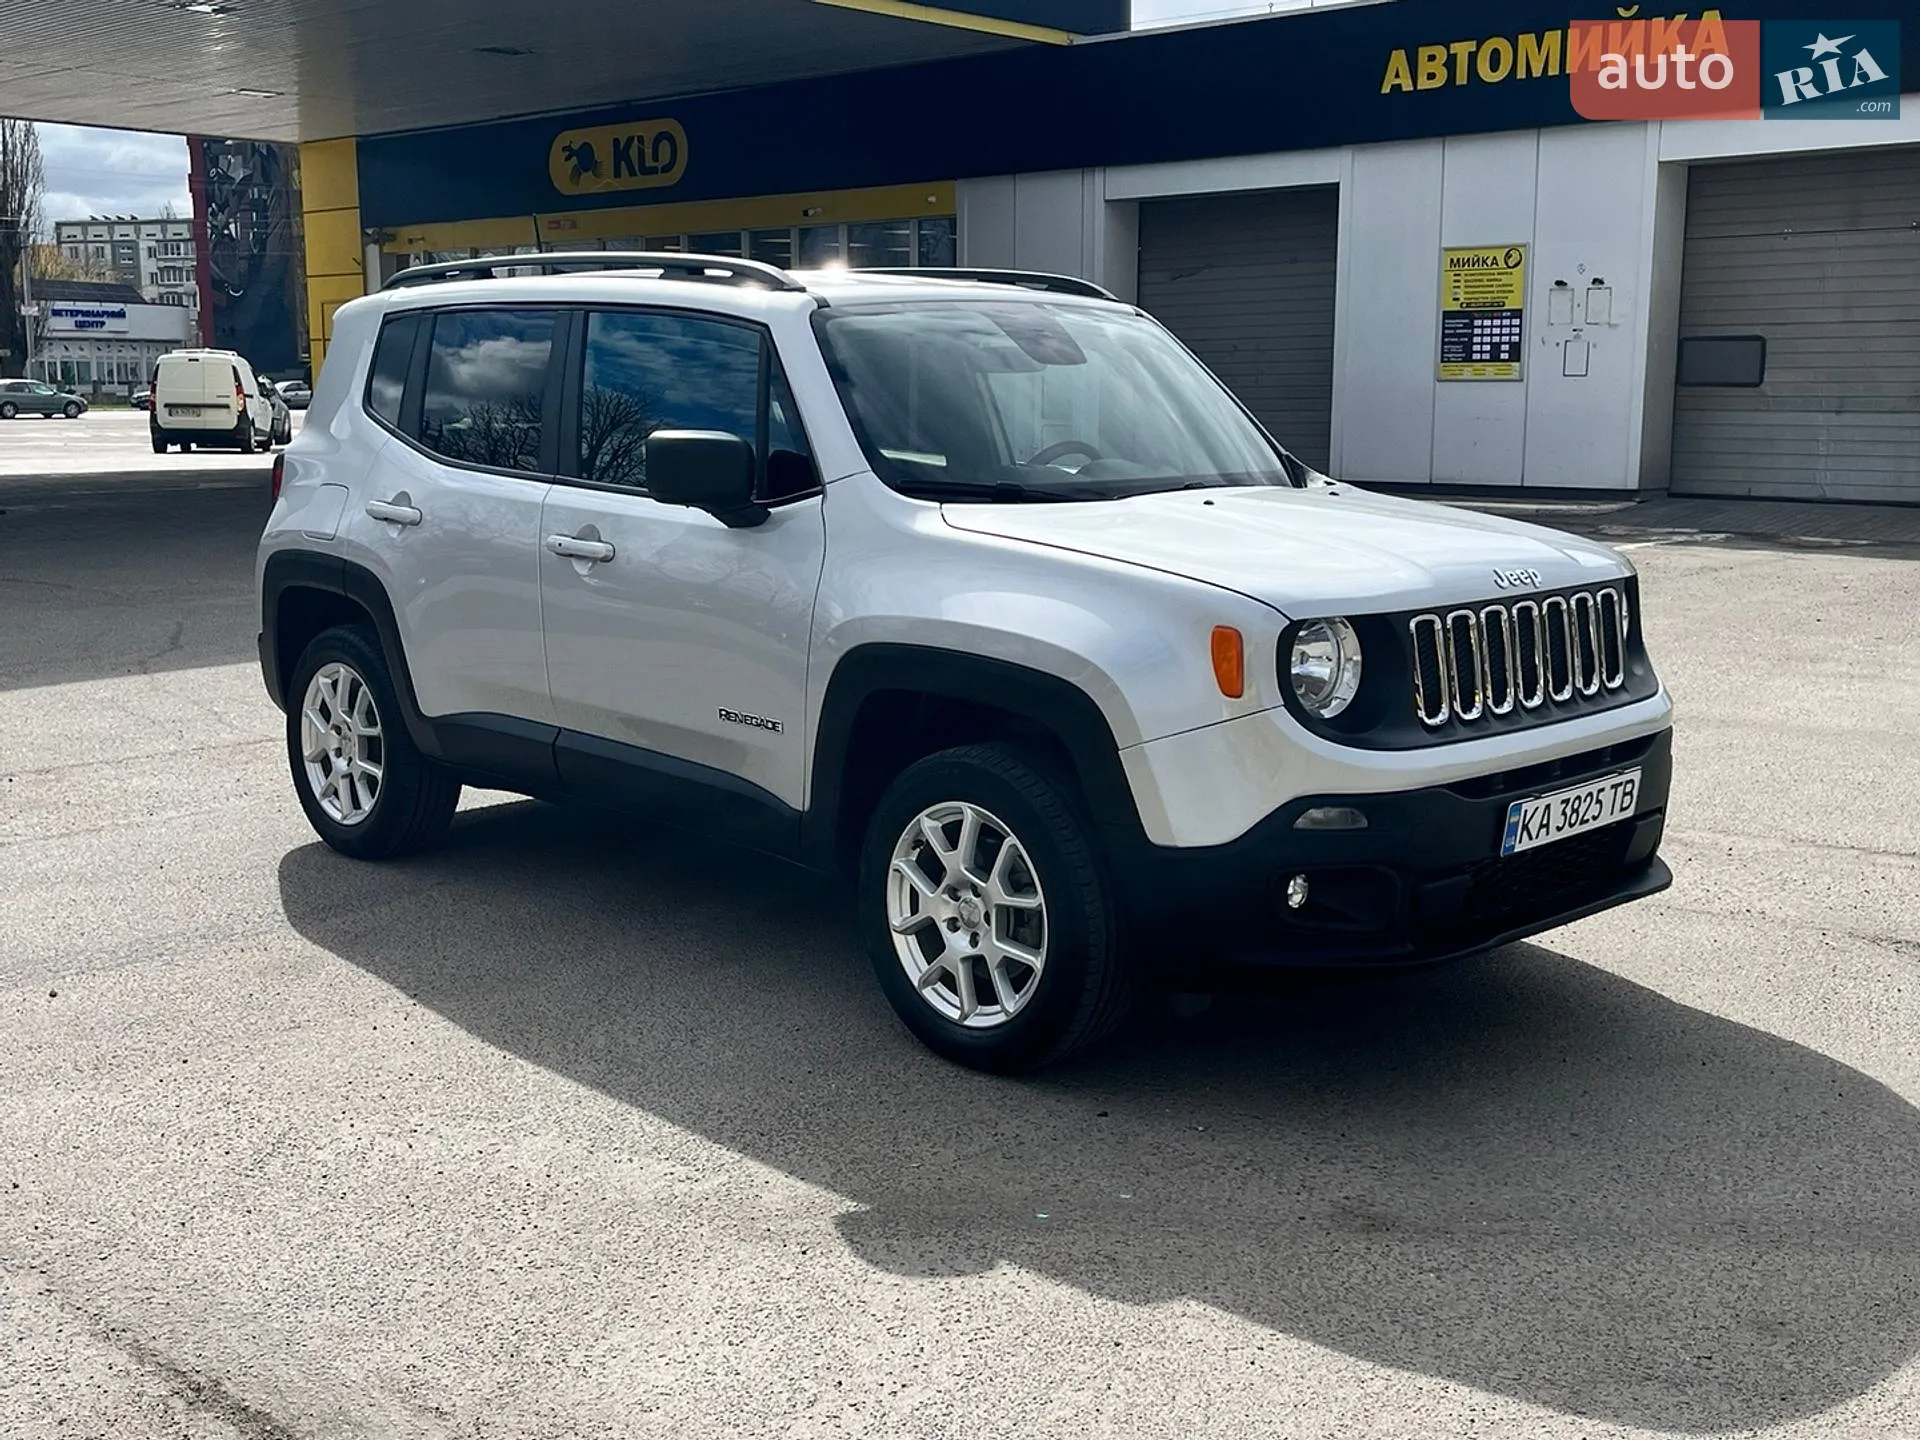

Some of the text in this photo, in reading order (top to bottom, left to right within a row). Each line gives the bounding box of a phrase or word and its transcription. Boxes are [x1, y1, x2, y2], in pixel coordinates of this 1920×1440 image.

[1380, 4, 1730, 95] АВТОМИЙКА
[611, 130, 679, 179] KLO
[1449, 254, 1500, 269] МИЙКА
[1492, 567, 1542, 590] Jeep
[717, 706, 784, 735] RENEGADE
[1518, 778, 1636, 845] KA 3825 TB
